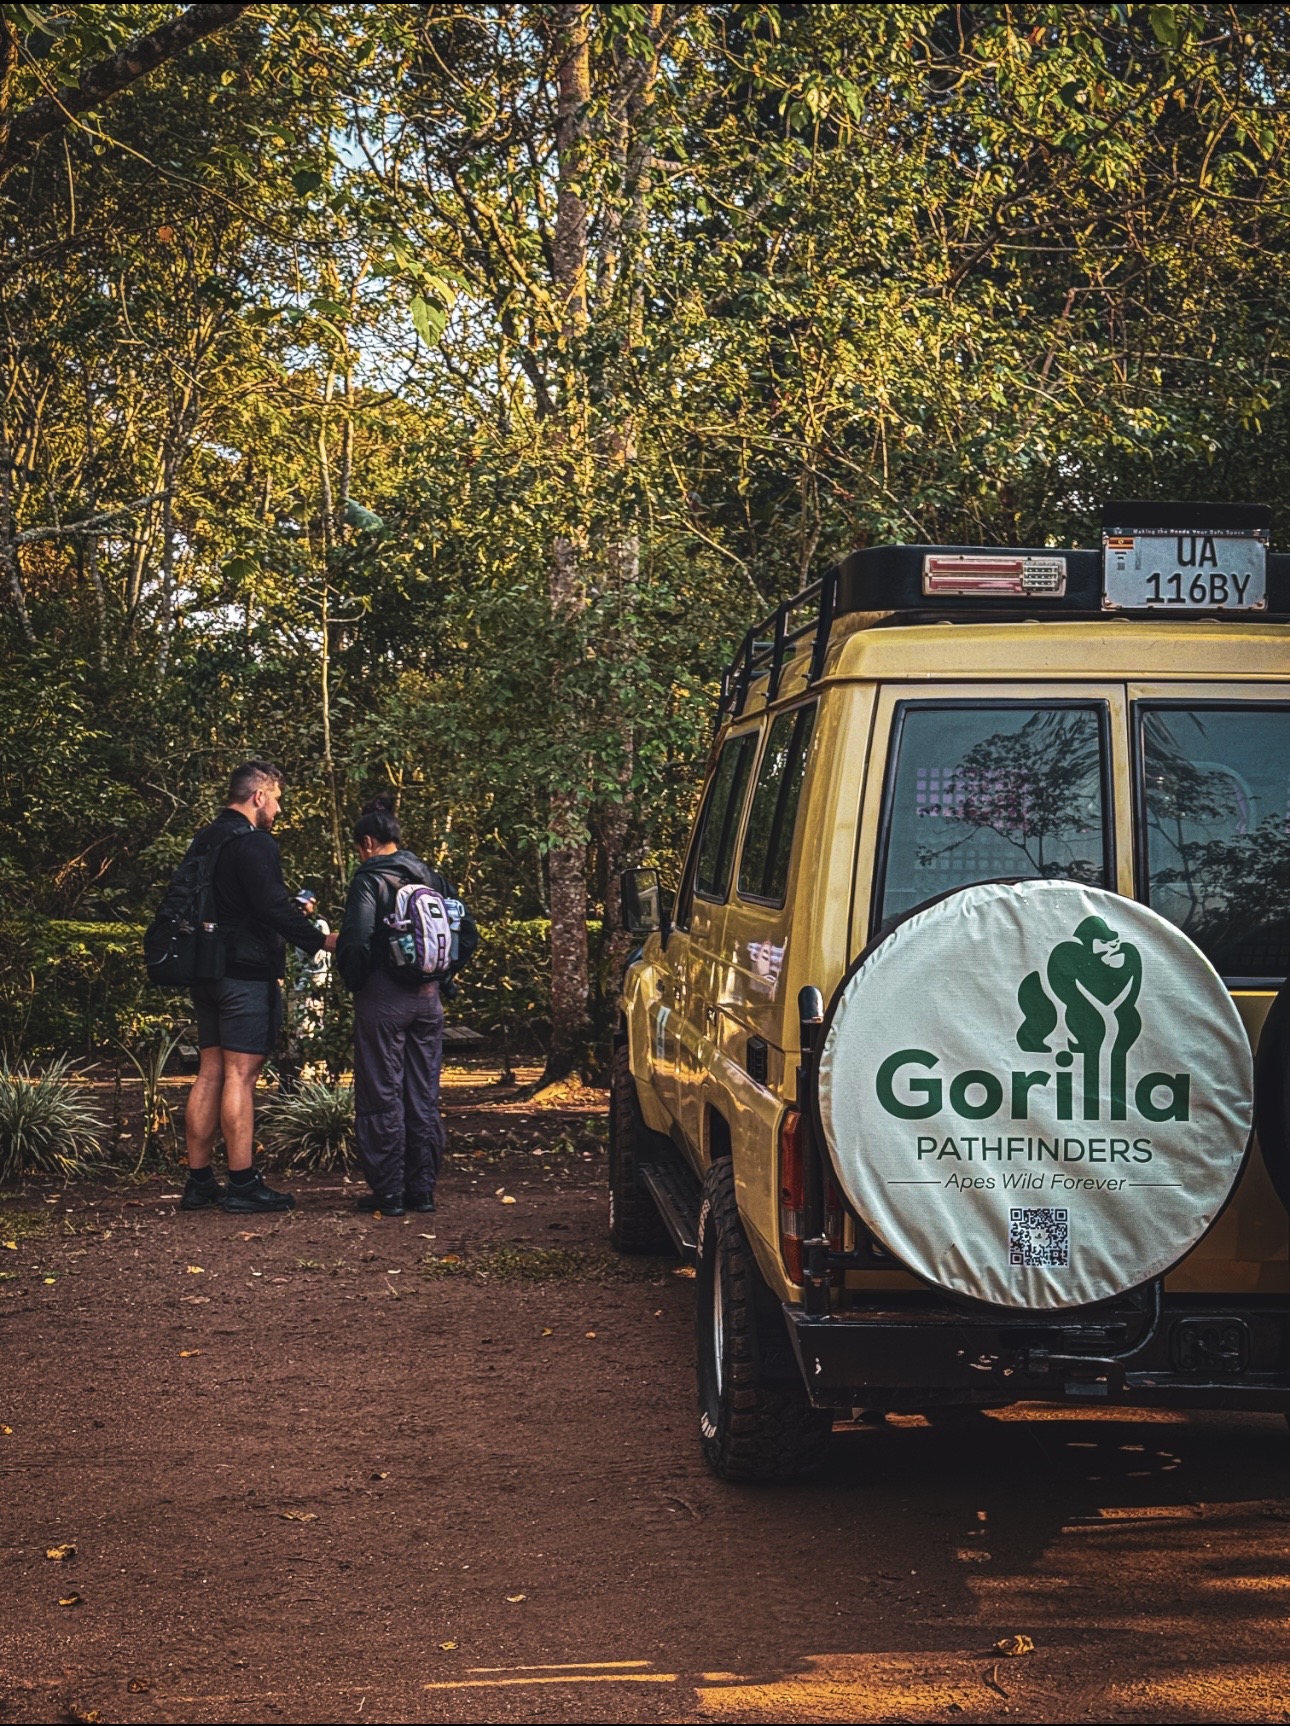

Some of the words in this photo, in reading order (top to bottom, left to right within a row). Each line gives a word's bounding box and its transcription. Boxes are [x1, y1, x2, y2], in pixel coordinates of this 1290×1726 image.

[1177, 537, 1218, 568] UA
[1146, 572, 1251, 605] 116BY
[875, 1048, 1191, 1122] Gorilla
[917, 1136, 1153, 1163] PATHFINDERS
[944, 1173, 996, 1191] Apes
[1002, 1173, 1045, 1190] Wild
[1050, 1174, 1126, 1191] Forever
